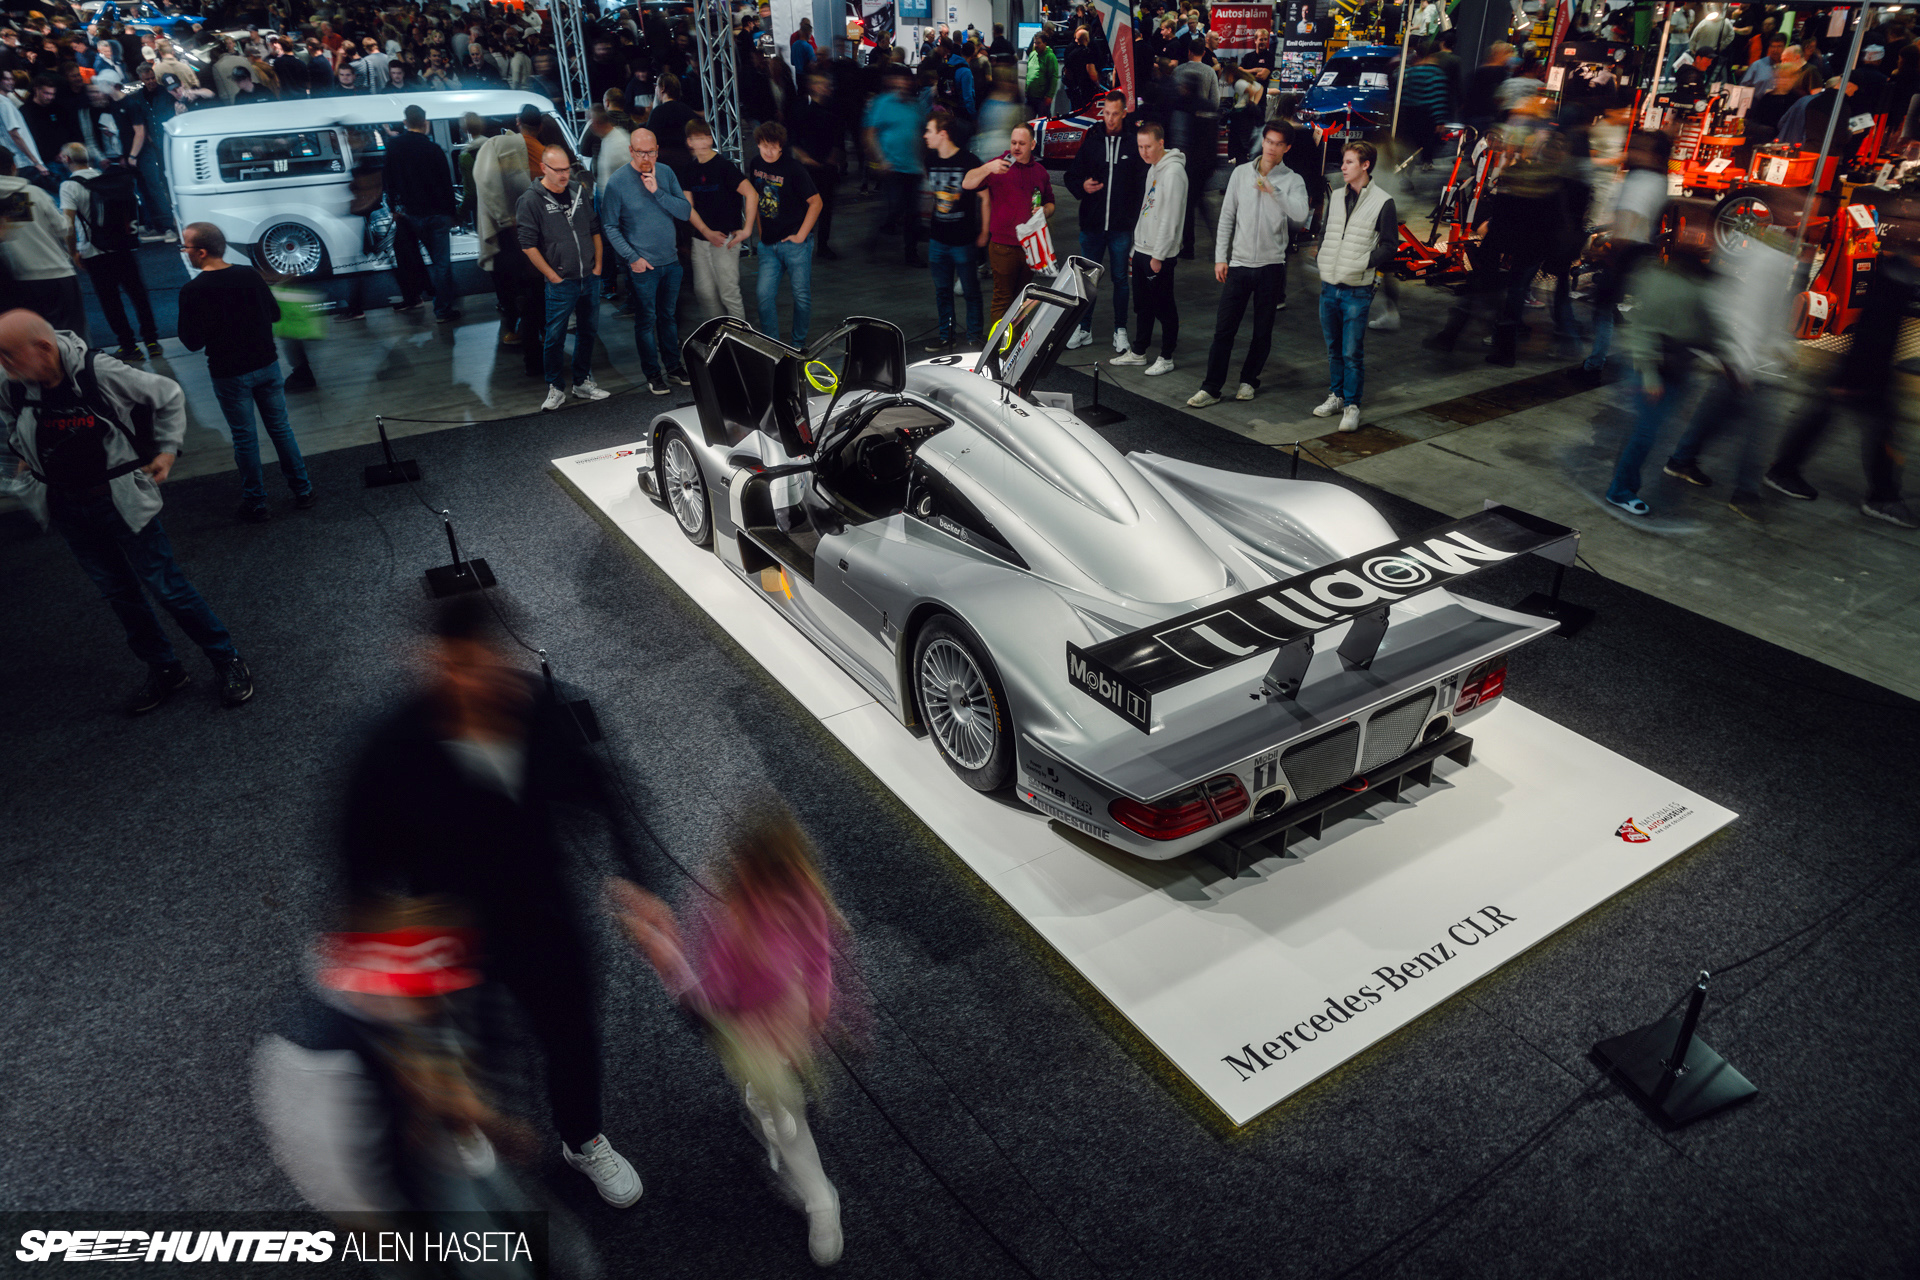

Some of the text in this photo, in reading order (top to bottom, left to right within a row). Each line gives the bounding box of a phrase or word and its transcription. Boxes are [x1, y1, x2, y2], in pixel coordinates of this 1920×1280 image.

[1215, 8, 1268, 18] Autoslalåm
[939, 519, 961, 536] becker
[1257, 531, 1518, 630] Mobil
[1070, 653, 1123, 707] Mobil
[1254, 749, 1279, 767] Mobil
[1068, 793, 1093, 816] H&R
[1638, 801, 1681, 827] NATIONALES
[1647, 805, 1688, 831] AUTOMUSEUM
[1220, 904, 1518, 1083] Mercedes-Benz CLR
